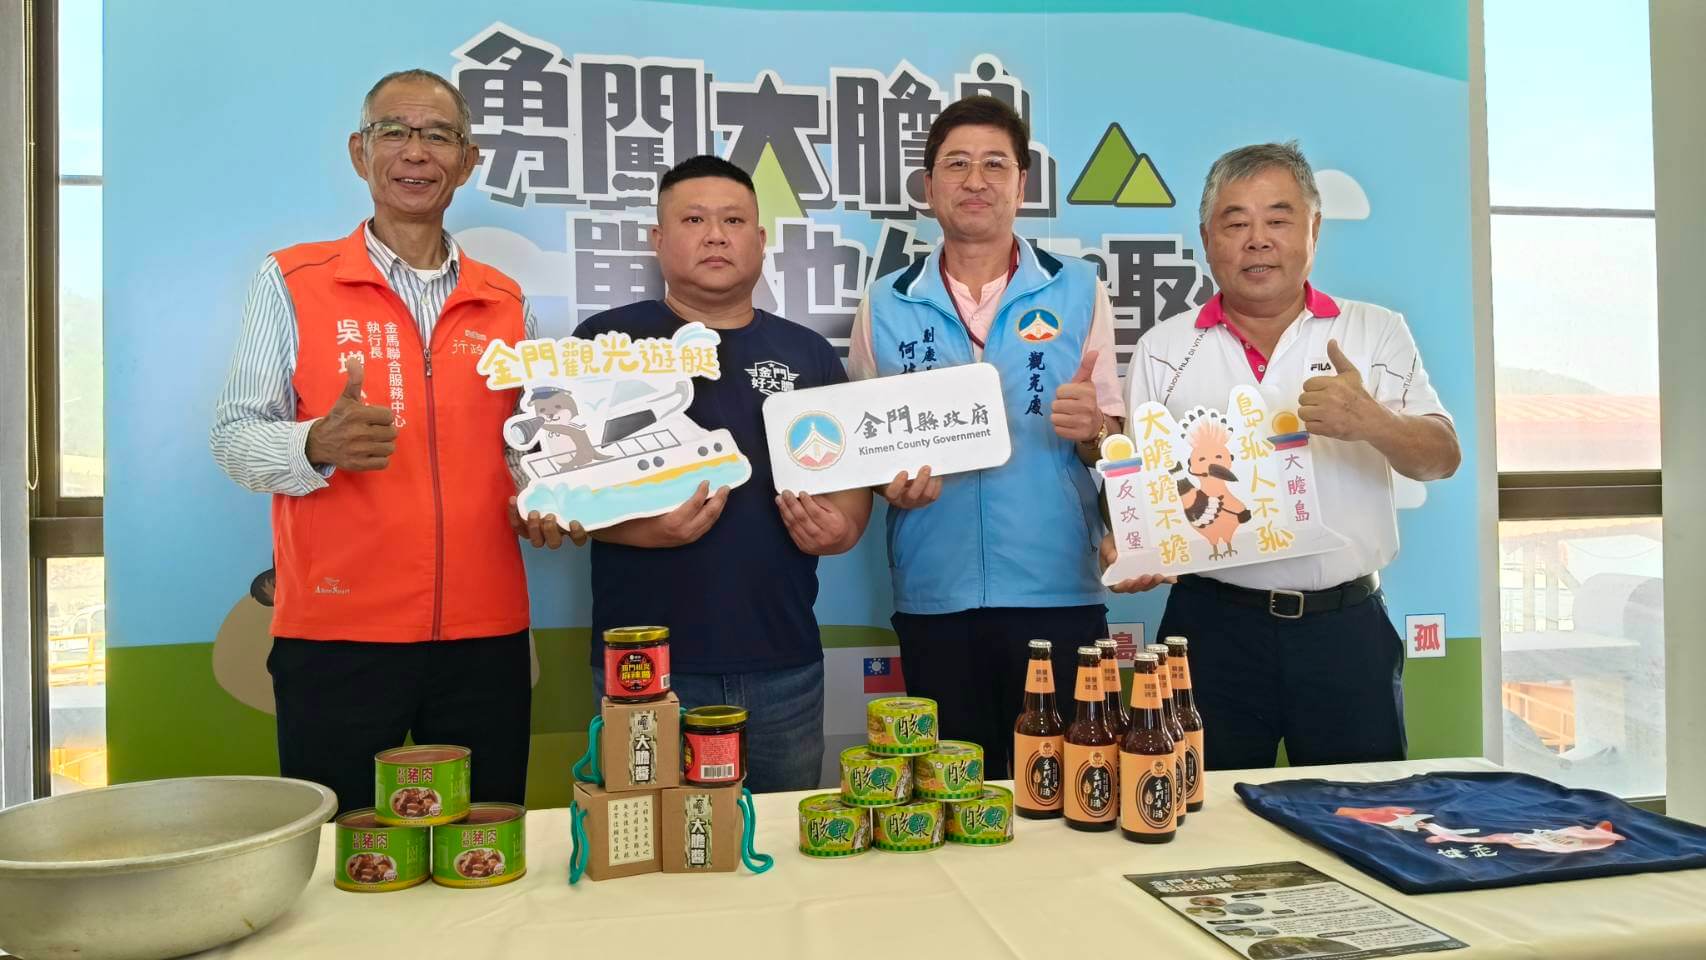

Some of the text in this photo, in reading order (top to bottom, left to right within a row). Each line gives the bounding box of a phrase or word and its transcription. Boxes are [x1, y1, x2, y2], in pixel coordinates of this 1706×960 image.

[366, 321, 383, 359] 執行長
[482, 337, 718, 386] 金門觀光遊艇
[383, 321, 406, 428] 金馬聯合服務中心
[757, 366, 788, 380] 金門
[1024, 350, 1046, 417] 觀光處
[1310, 362, 1332, 371] FILA
[854, 402, 989, 439] 金門縣政府
[858, 428, 991, 456] Kinmen County Government
[1137, 408, 1191, 566] 大膽擔不擔
[1235, 392, 1295, 552] 島孤人不孤
[1284, 453, 1310, 522] 大膽島
[1116, 479, 1145, 550] 反攻堡
[1414, 622, 1440, 651] 孤
